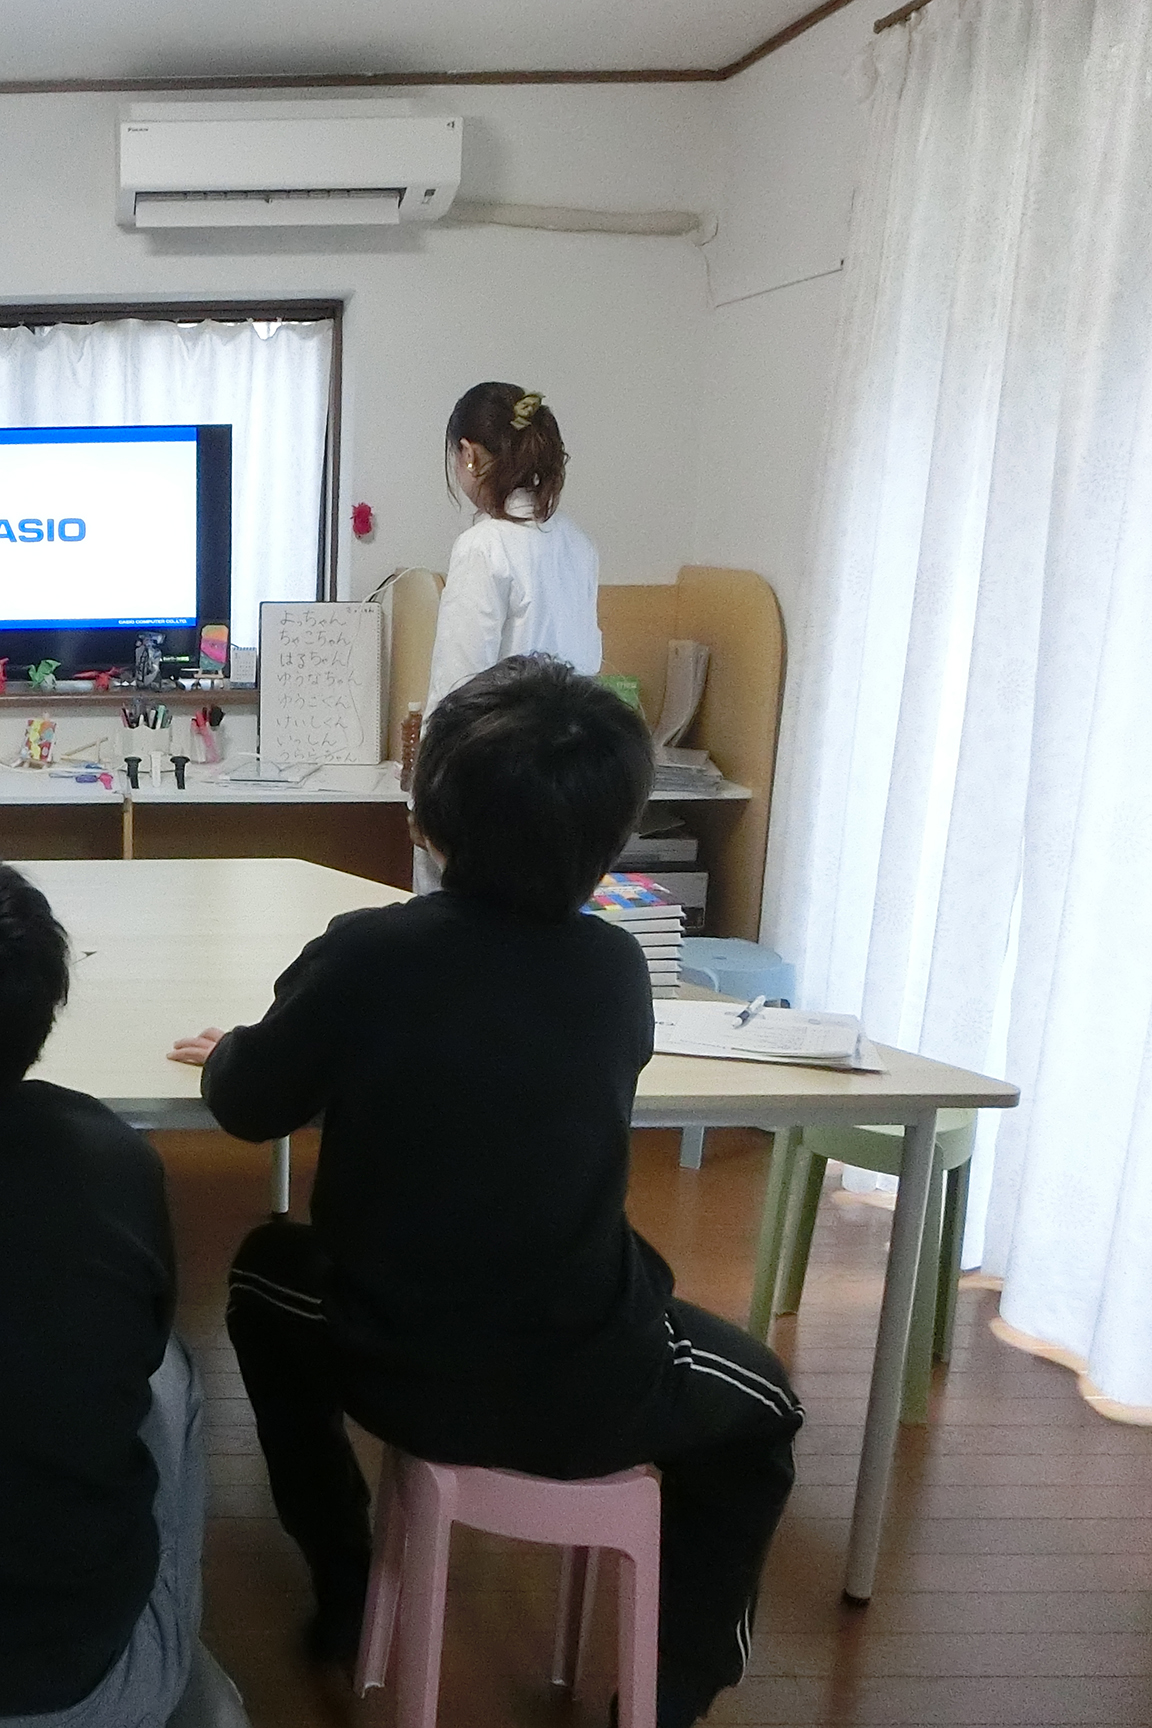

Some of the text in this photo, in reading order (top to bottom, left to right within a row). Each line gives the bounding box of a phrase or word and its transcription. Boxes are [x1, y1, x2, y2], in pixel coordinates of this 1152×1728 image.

[280, 610, 346, 627] よっちゃん
[280, 629, 350, 647] ちゃこちゃん
[280, 650, 346, 669] はるちゃん
[277, 670, 363, 687] ゆうなちゃん
